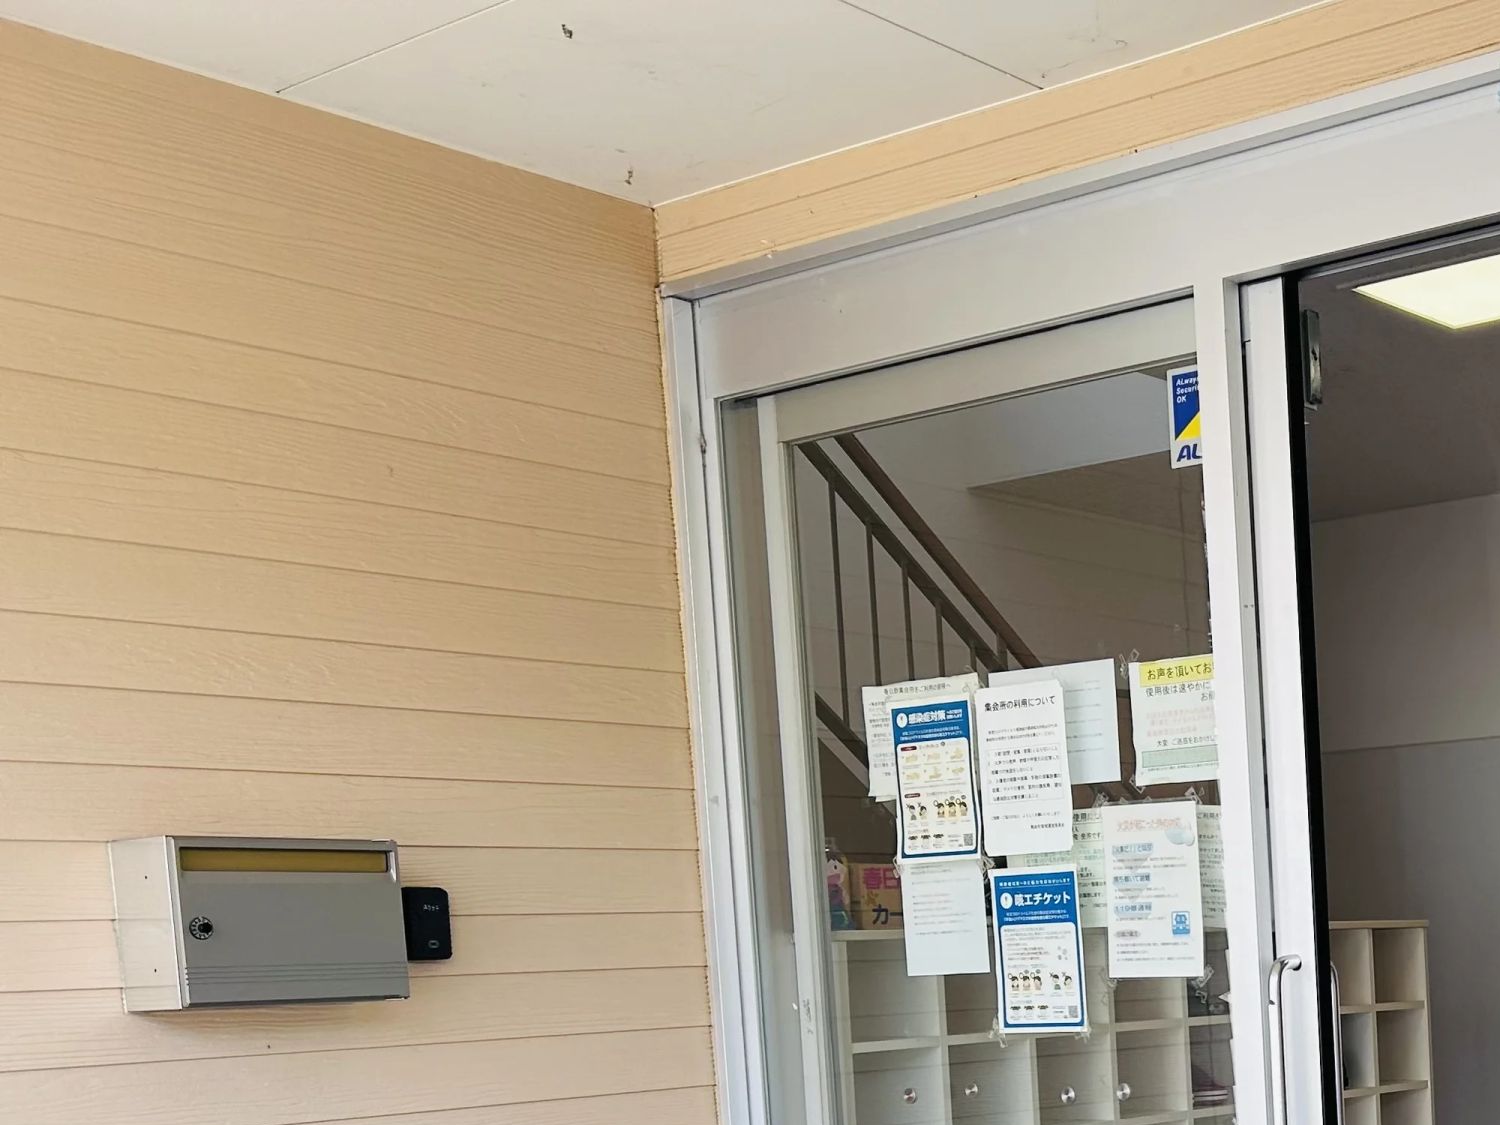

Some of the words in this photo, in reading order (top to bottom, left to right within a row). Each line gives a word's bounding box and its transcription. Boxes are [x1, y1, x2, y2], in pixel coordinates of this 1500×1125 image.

[1176, 385, 1199, 395] Securi
[1176, 395, 1187, 404] OK
[1147, 663, 1214, 680] お声を頂いてお
